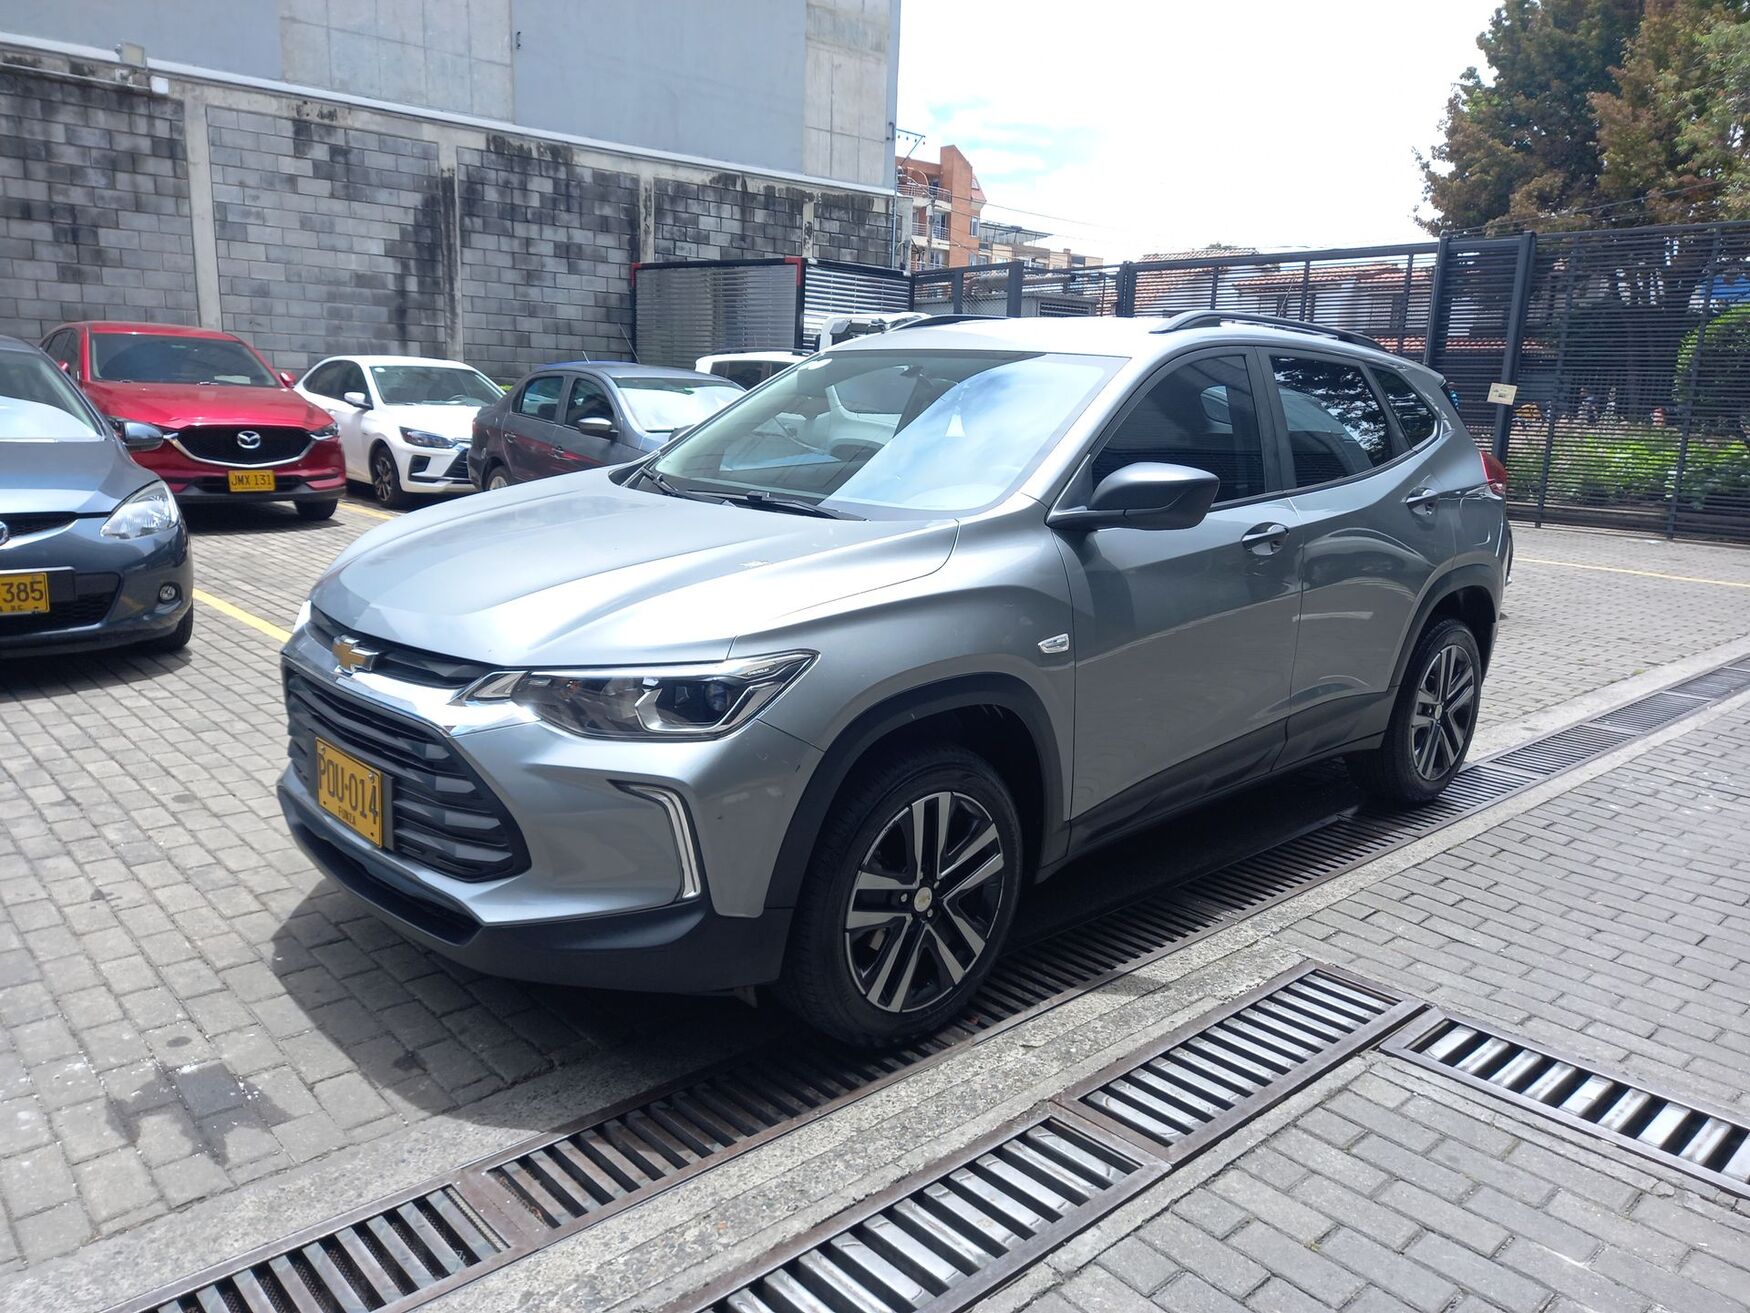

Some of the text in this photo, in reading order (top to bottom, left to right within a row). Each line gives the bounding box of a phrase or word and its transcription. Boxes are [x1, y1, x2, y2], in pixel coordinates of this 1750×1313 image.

[231, 474, 271, 486] JMX 131
[1, 581, 43, 604] 385
